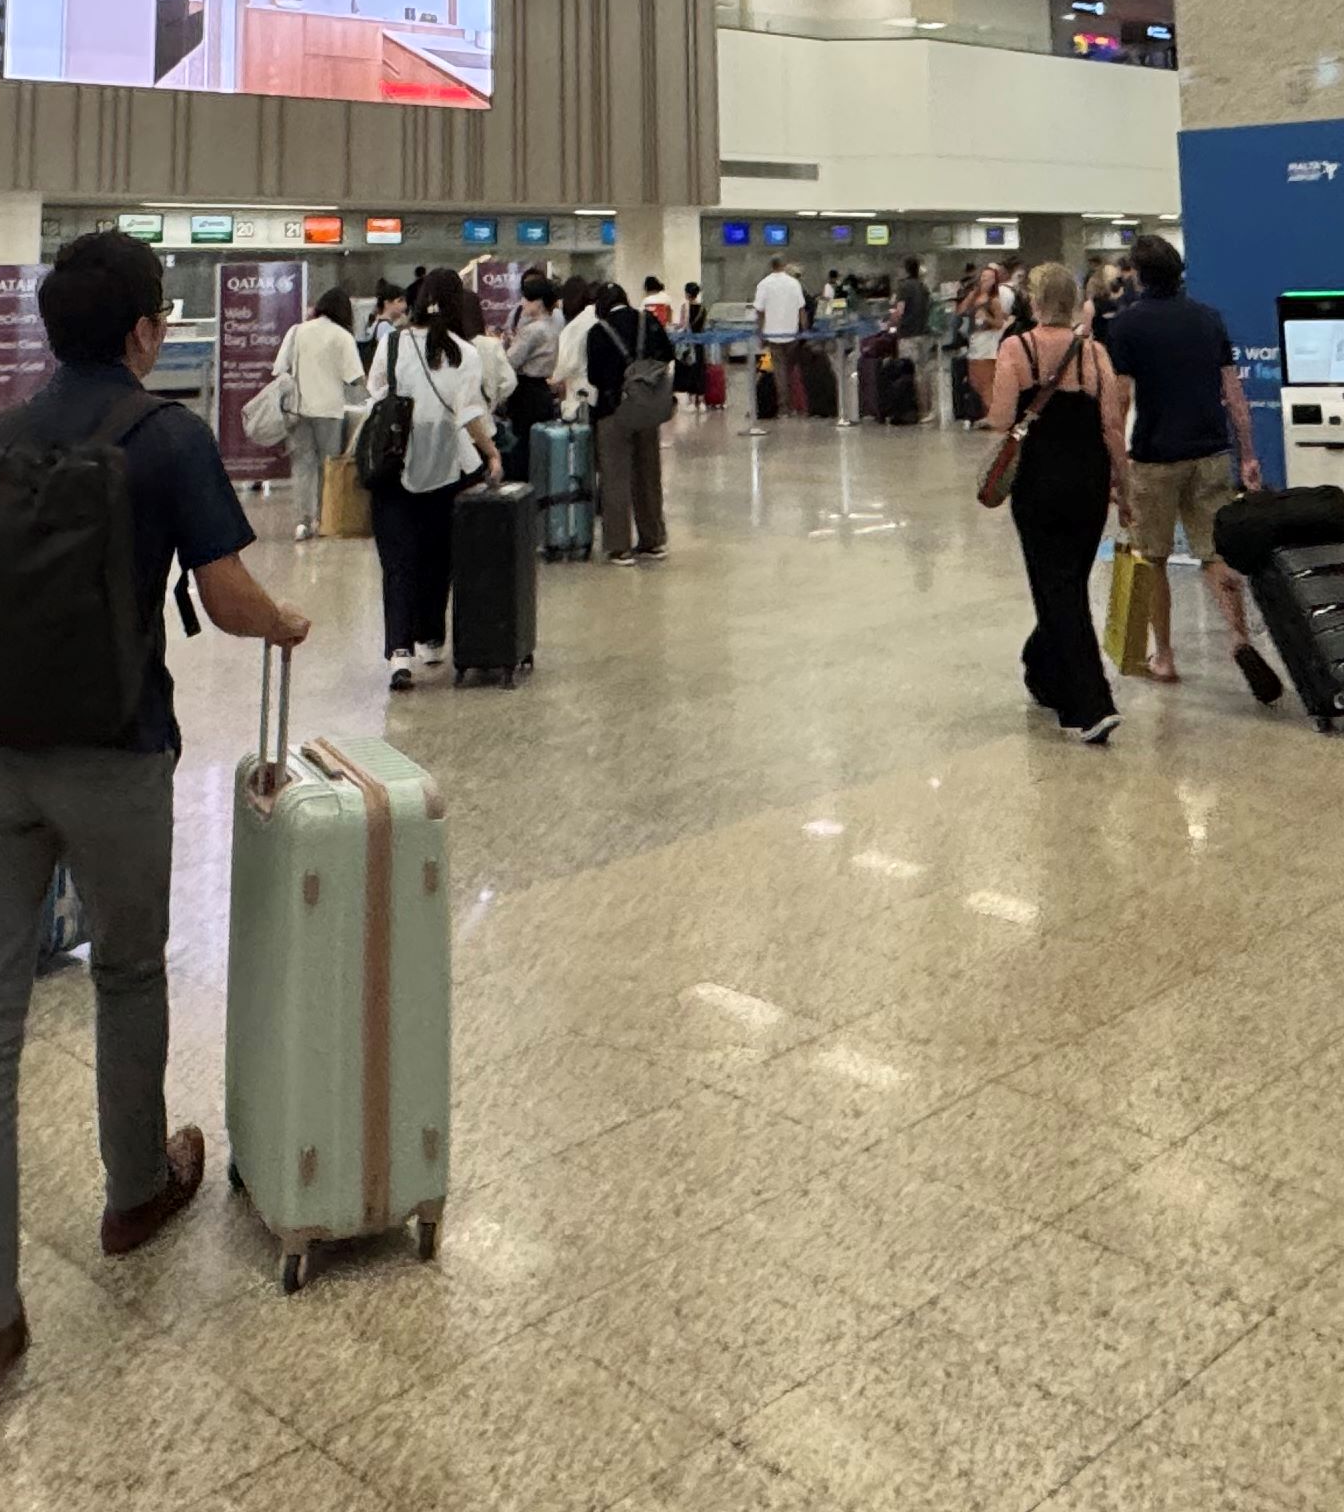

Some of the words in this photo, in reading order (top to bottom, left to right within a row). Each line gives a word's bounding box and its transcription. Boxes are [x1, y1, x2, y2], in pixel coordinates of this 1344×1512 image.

[237, 221, 254, 237] 20
[286, 222, 301, 237] 21
[226, 275, 275, 292] QATAR
